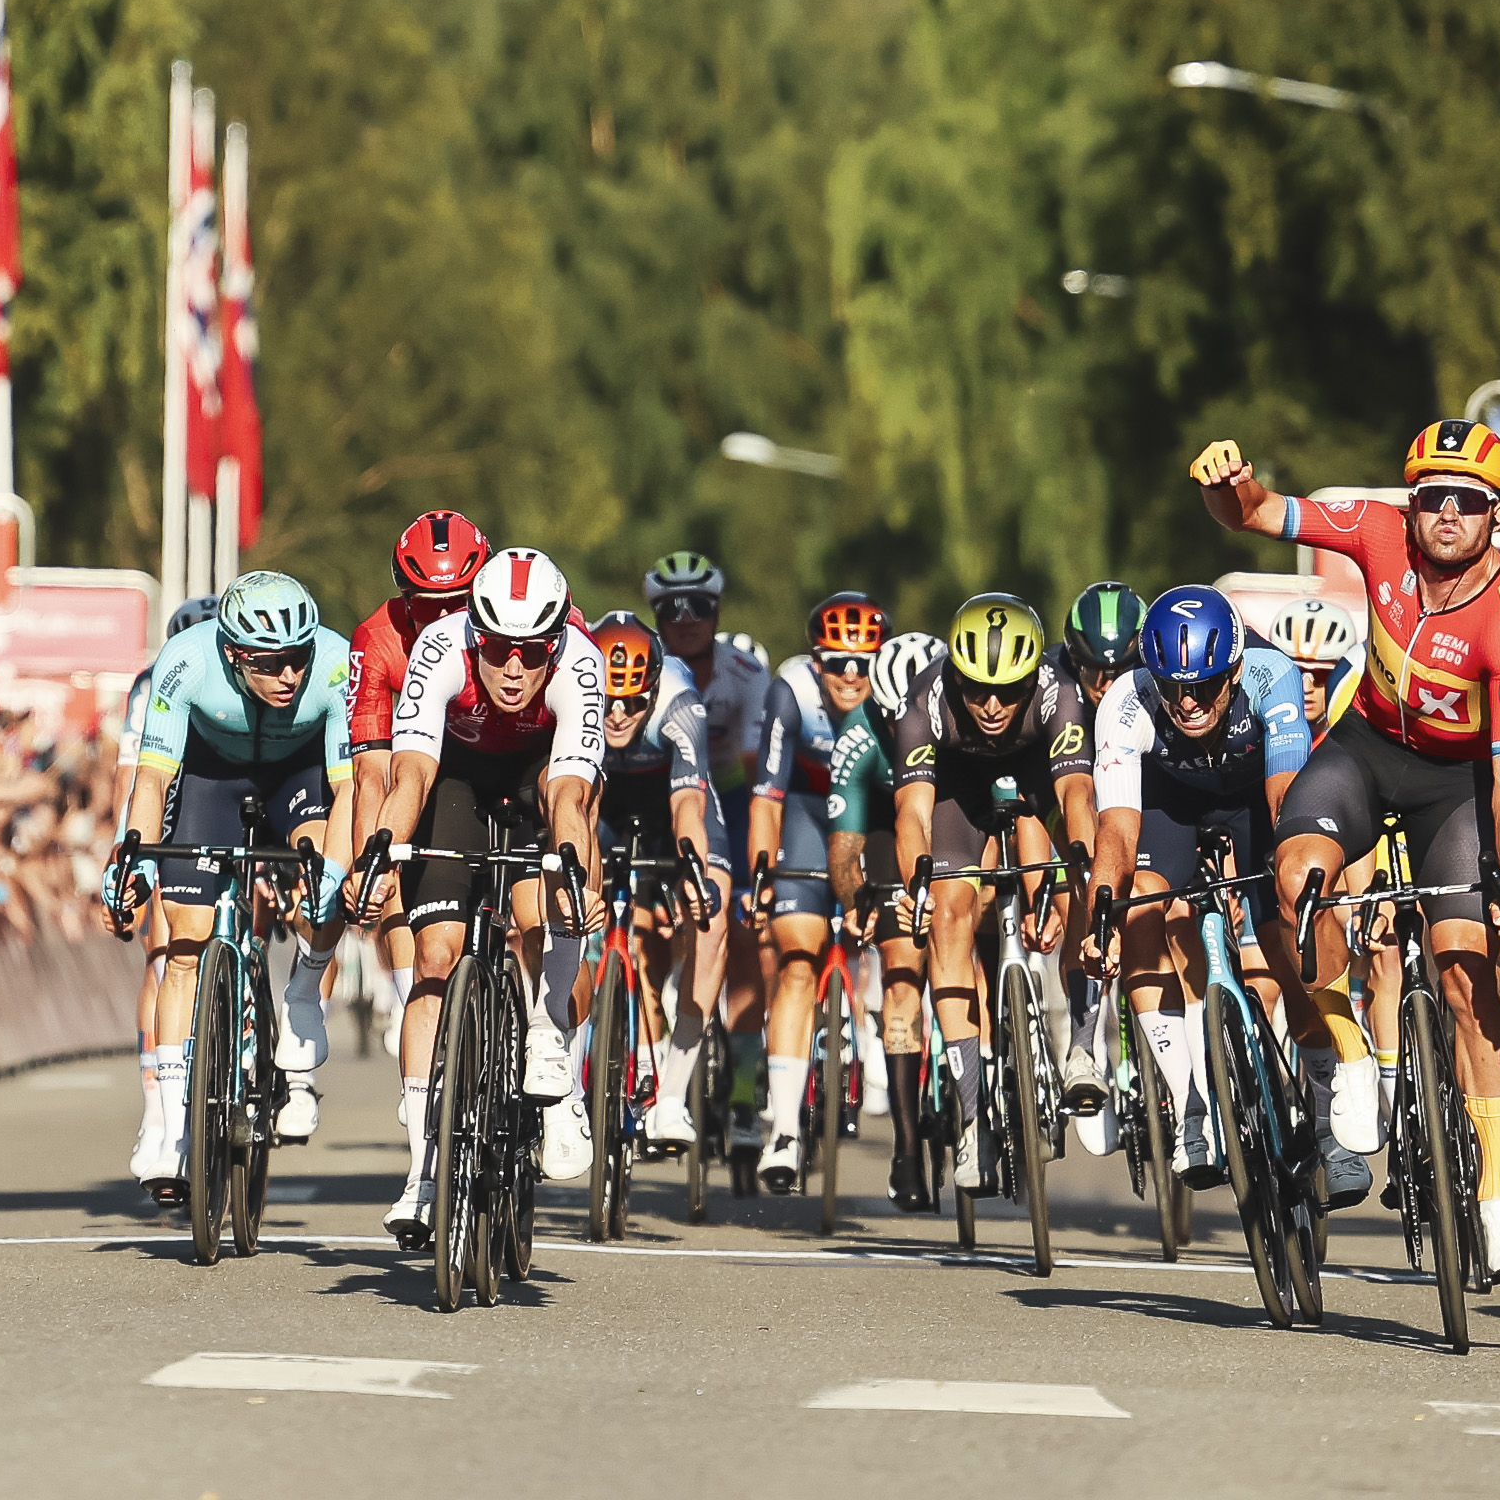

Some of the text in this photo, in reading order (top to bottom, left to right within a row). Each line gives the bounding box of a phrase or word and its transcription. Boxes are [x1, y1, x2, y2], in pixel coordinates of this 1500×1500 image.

[1430, 647, 1464, 666] 1000
[1431, 632, 1471, 655] REMA
[158, 660, 189, 696] FREEDOM
[396, 632, 453, 720] Cofidis
[571, 656, 605, 752] Cofidis
[1204, 919, 1223, 975] FACTOR
